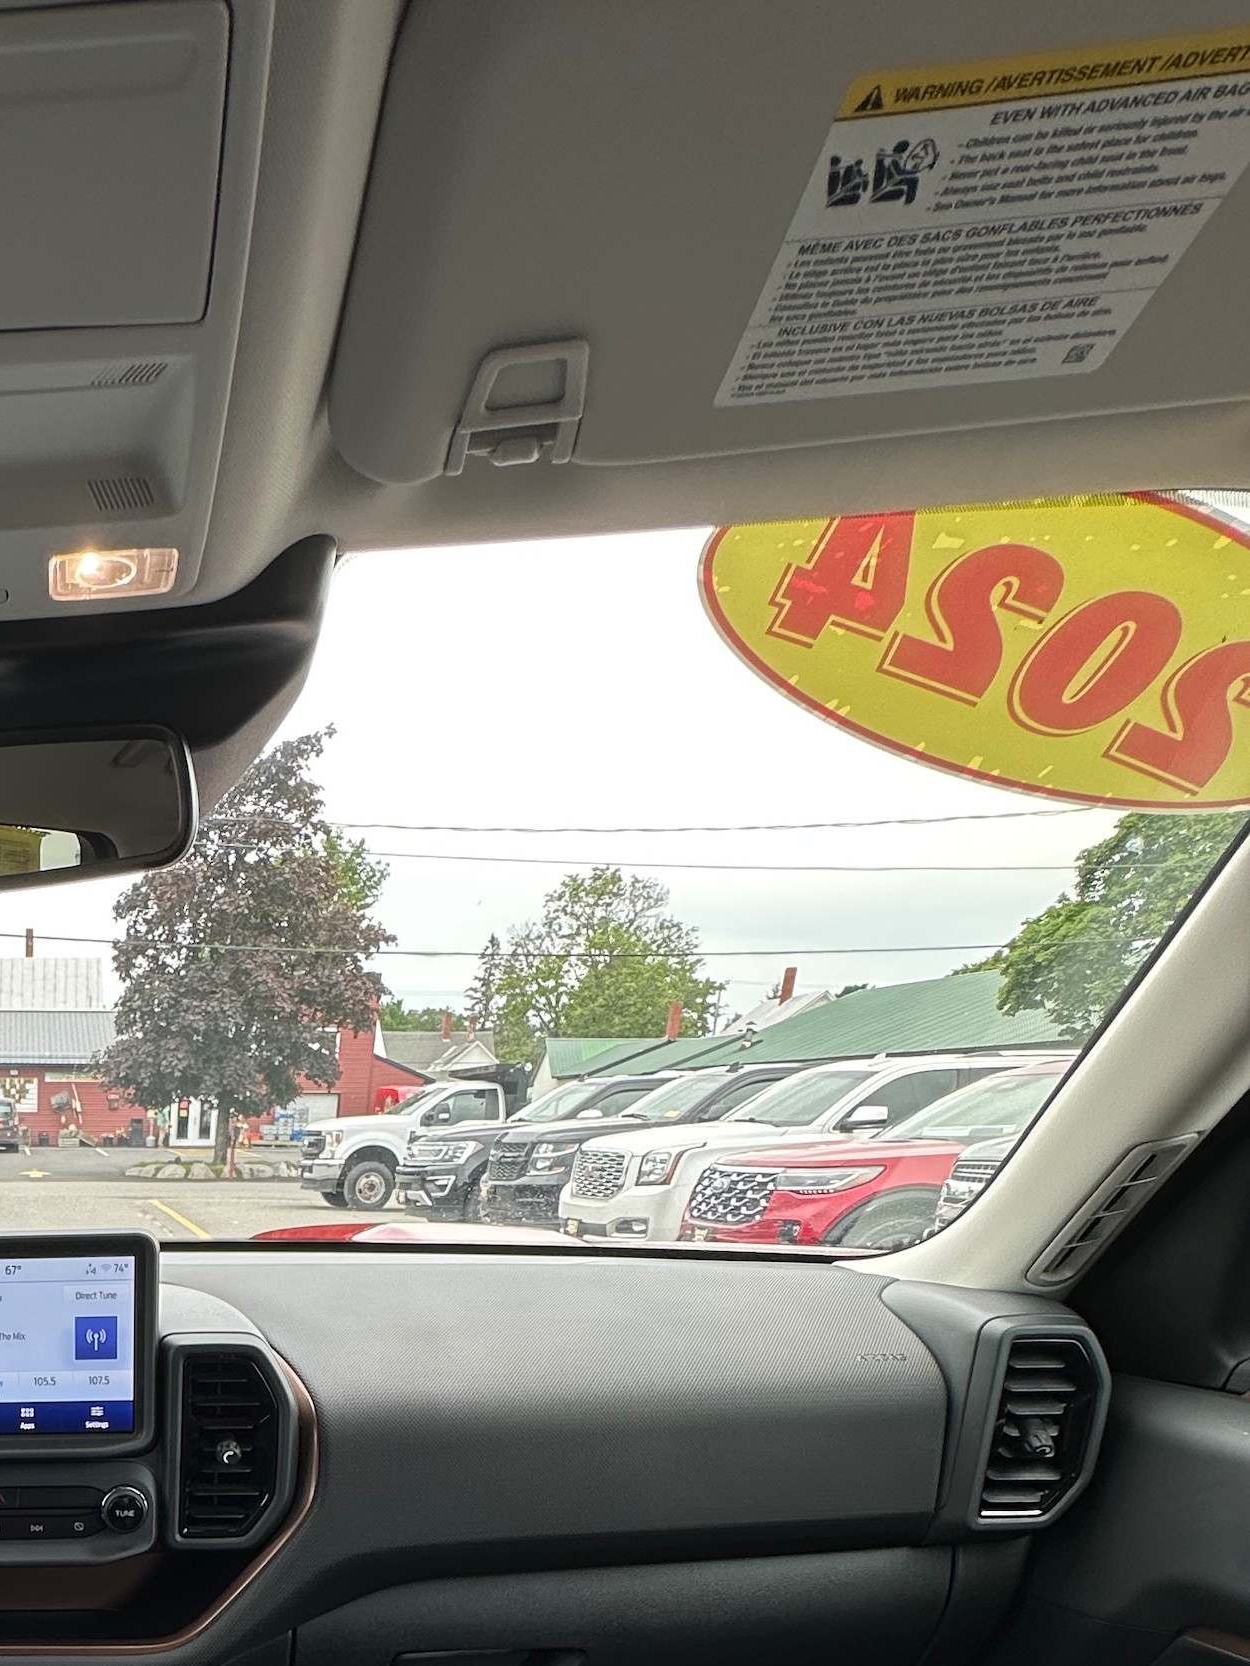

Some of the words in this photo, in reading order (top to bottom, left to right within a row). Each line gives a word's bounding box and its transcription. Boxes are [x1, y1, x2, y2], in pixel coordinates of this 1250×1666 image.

[894, 79, 984, 103] WARNING
[990, 107, 1038, 125] EVEN
[1040, 102, 1085, 120] WITH
[1083, 91, 1179, 115] ADVANCED
[1179, 87, 1211, 104] AIR
[843, 237, 885, 252] AVEC
[887, 234, 916, 247] DES
[919, 229, 964, 244] SACS
[778, 322, 851, 337] INCLUSIVE
[853, 318, 885, 331] CON
[886, 314, 916, 327] LAS
[918, 309, 975, 324] NUEVAS
[978, 303, 1038, 318] BOLSAS
[1040, 300, 1061, 312] DE
[1062, 296, 1101, 309] AIRE
[5, 1264, 22, 1276] 67°
[114, 1263, 129, 1273] 74°
[75, 1291, 95, 1301] Direct
[97, 1290, 117, 1300] Tune
[13, 1332, 26, 1341] Mix
[34, 1377, 56, 1386] 105.5
[88, 1376, 110, 1385] 107.5
[20, 1422, 35, 1431] Apps
[85, 1421, 109, 1430] Settings
